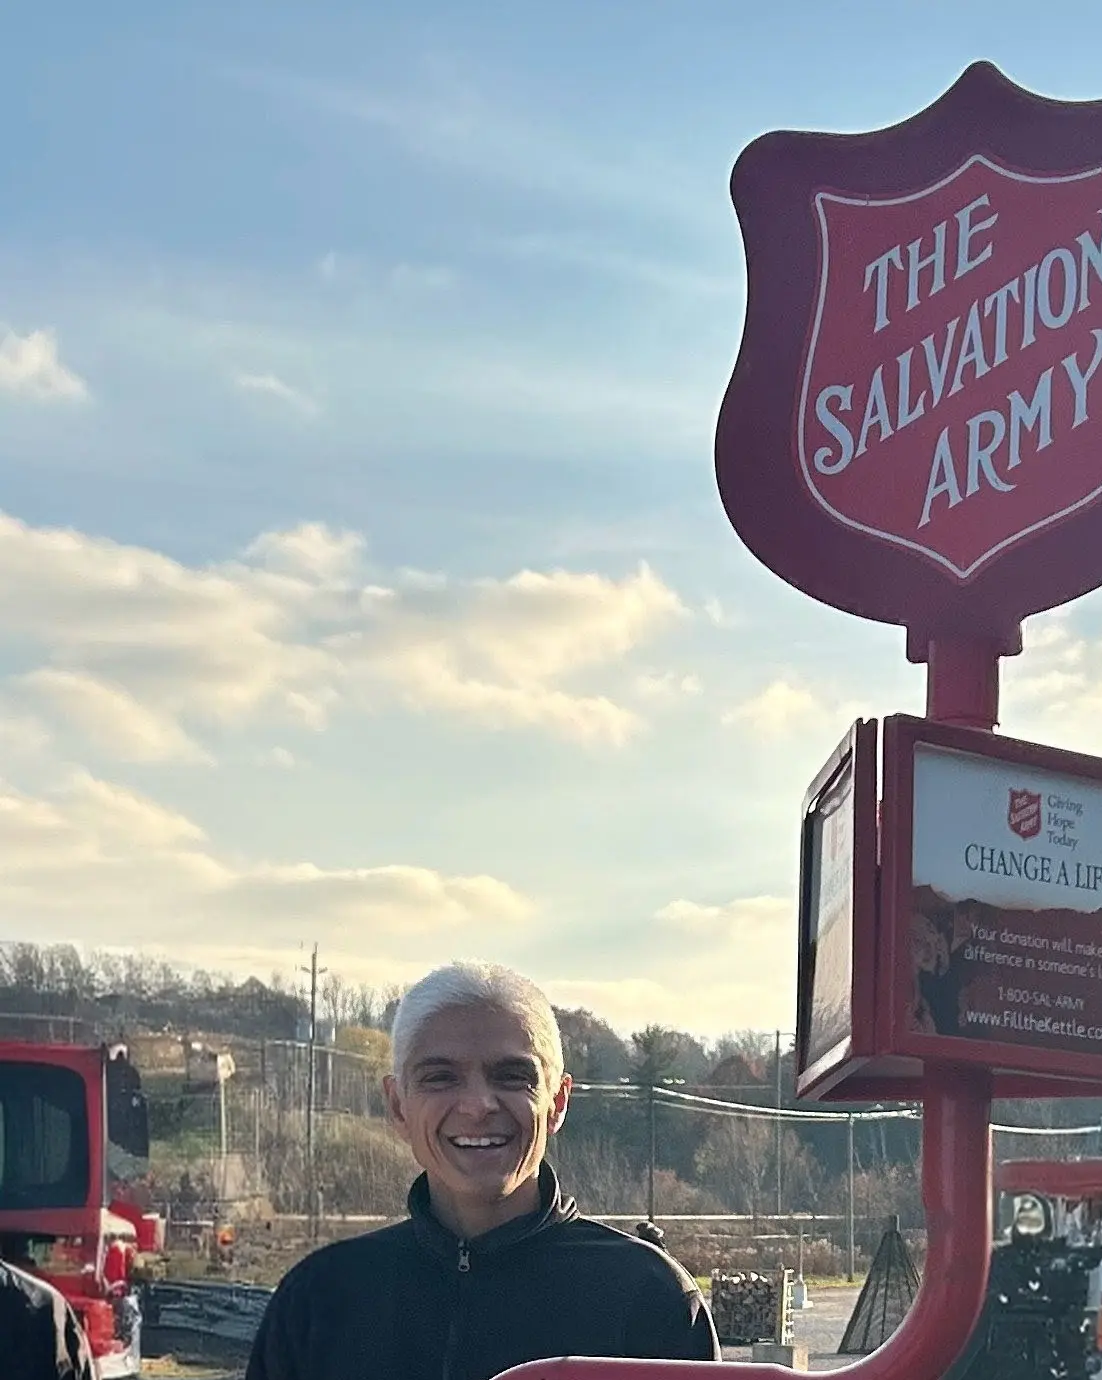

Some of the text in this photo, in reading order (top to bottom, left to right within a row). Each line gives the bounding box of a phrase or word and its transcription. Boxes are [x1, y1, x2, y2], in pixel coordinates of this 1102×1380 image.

[863, 194, 999, 333] THE
[1047, 794, 1084, 816] Giving
[1047, 812, 1075, 831] Hope
[1046, 830, 1079, 852] Today
[964, 843, 1051, 883] CHANGE
[1056, 860, 1069, 886] A
[970, 922, 997, 941] Your
[1000, 928, 1049, 950] donation
[1052, 936, 1073, 954] will
[964, 944, 1023, 968] difference
[1025, 957, 1036, 969] in
